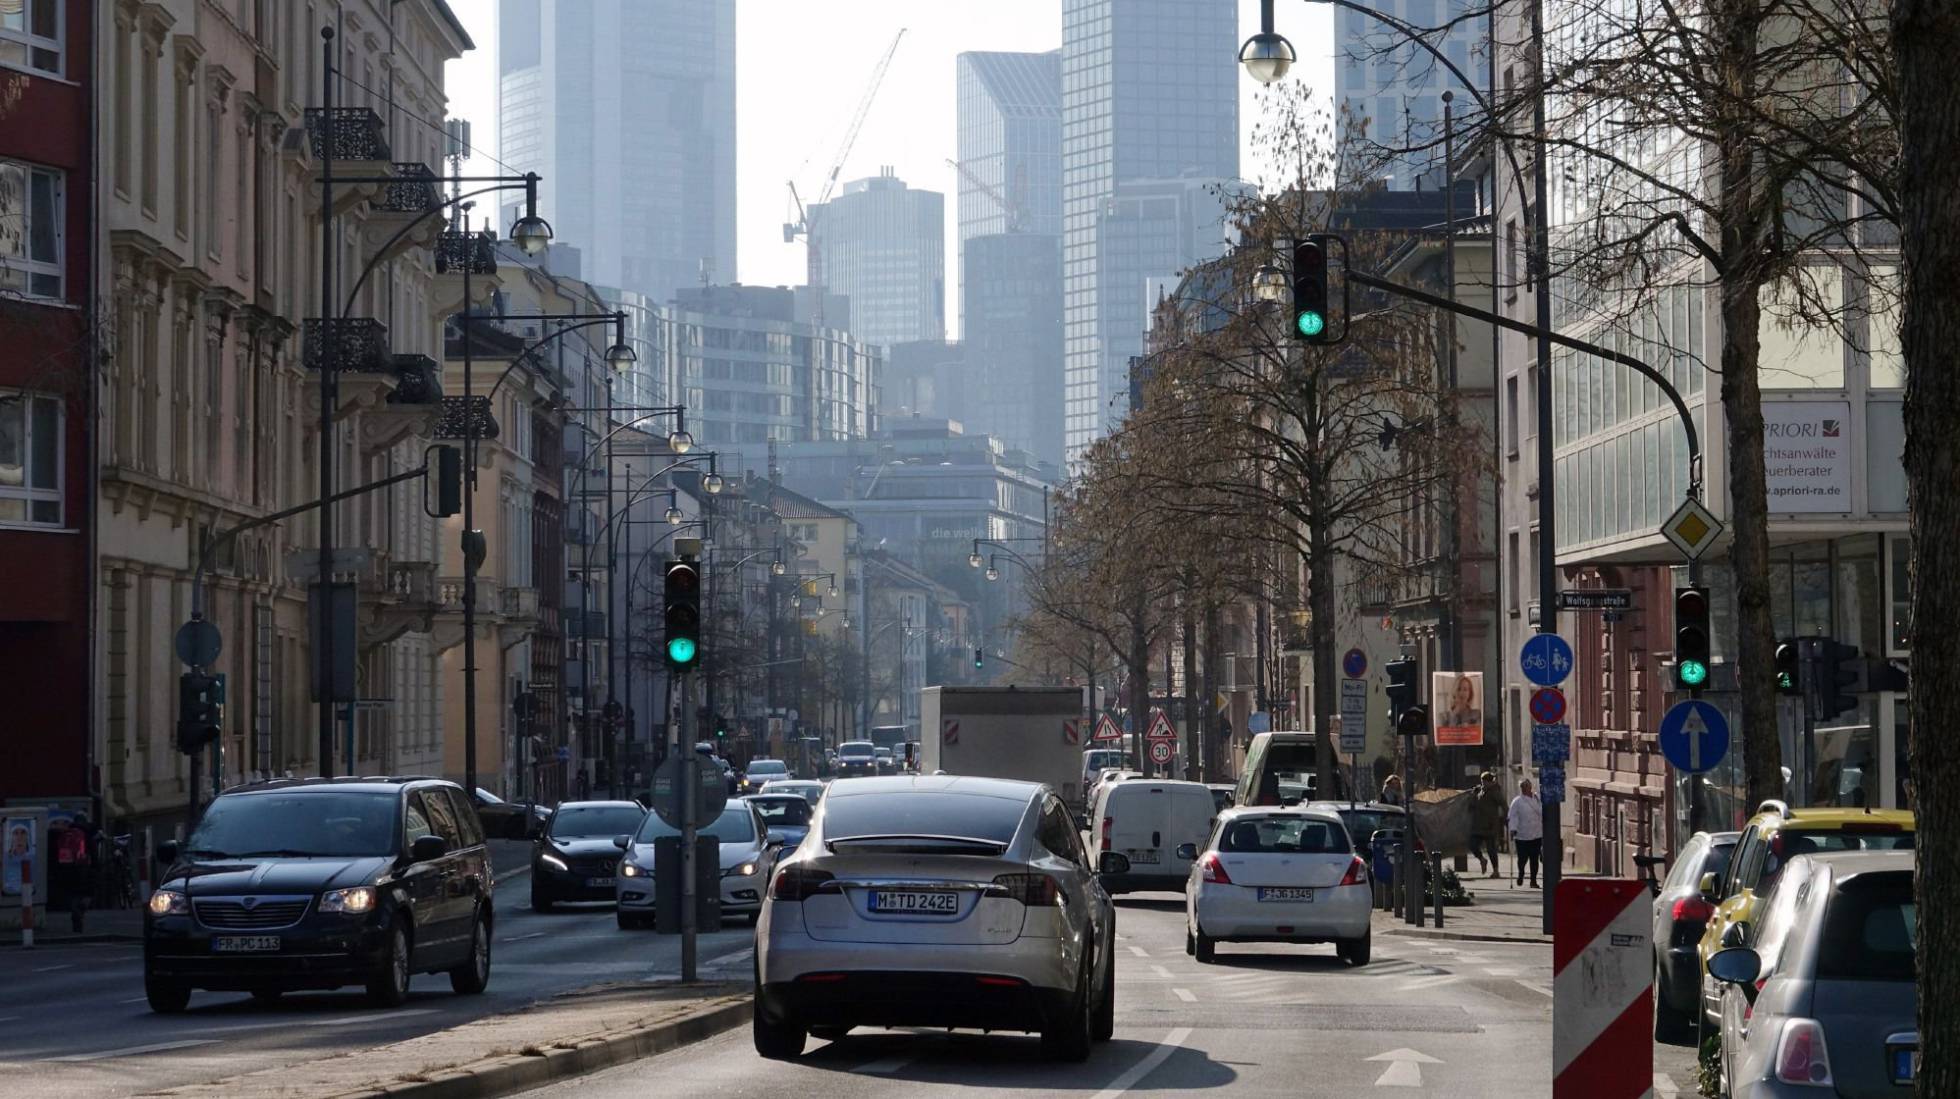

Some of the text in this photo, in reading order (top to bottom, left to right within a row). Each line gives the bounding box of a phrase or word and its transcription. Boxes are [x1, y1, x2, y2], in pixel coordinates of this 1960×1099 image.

[1762, 423, 1817, 437] PRIORI
[1763, 446, 1836, 459] chtsanwälte
[1765, 465, 1832, 477] uerberater
[1766, 485, 1841, 497] .apriori-ra.de
[931, 527, 951, 538] die
[1155, 746, 1168, 757] 30
[878, 893, 955, 910] M TD 242E
